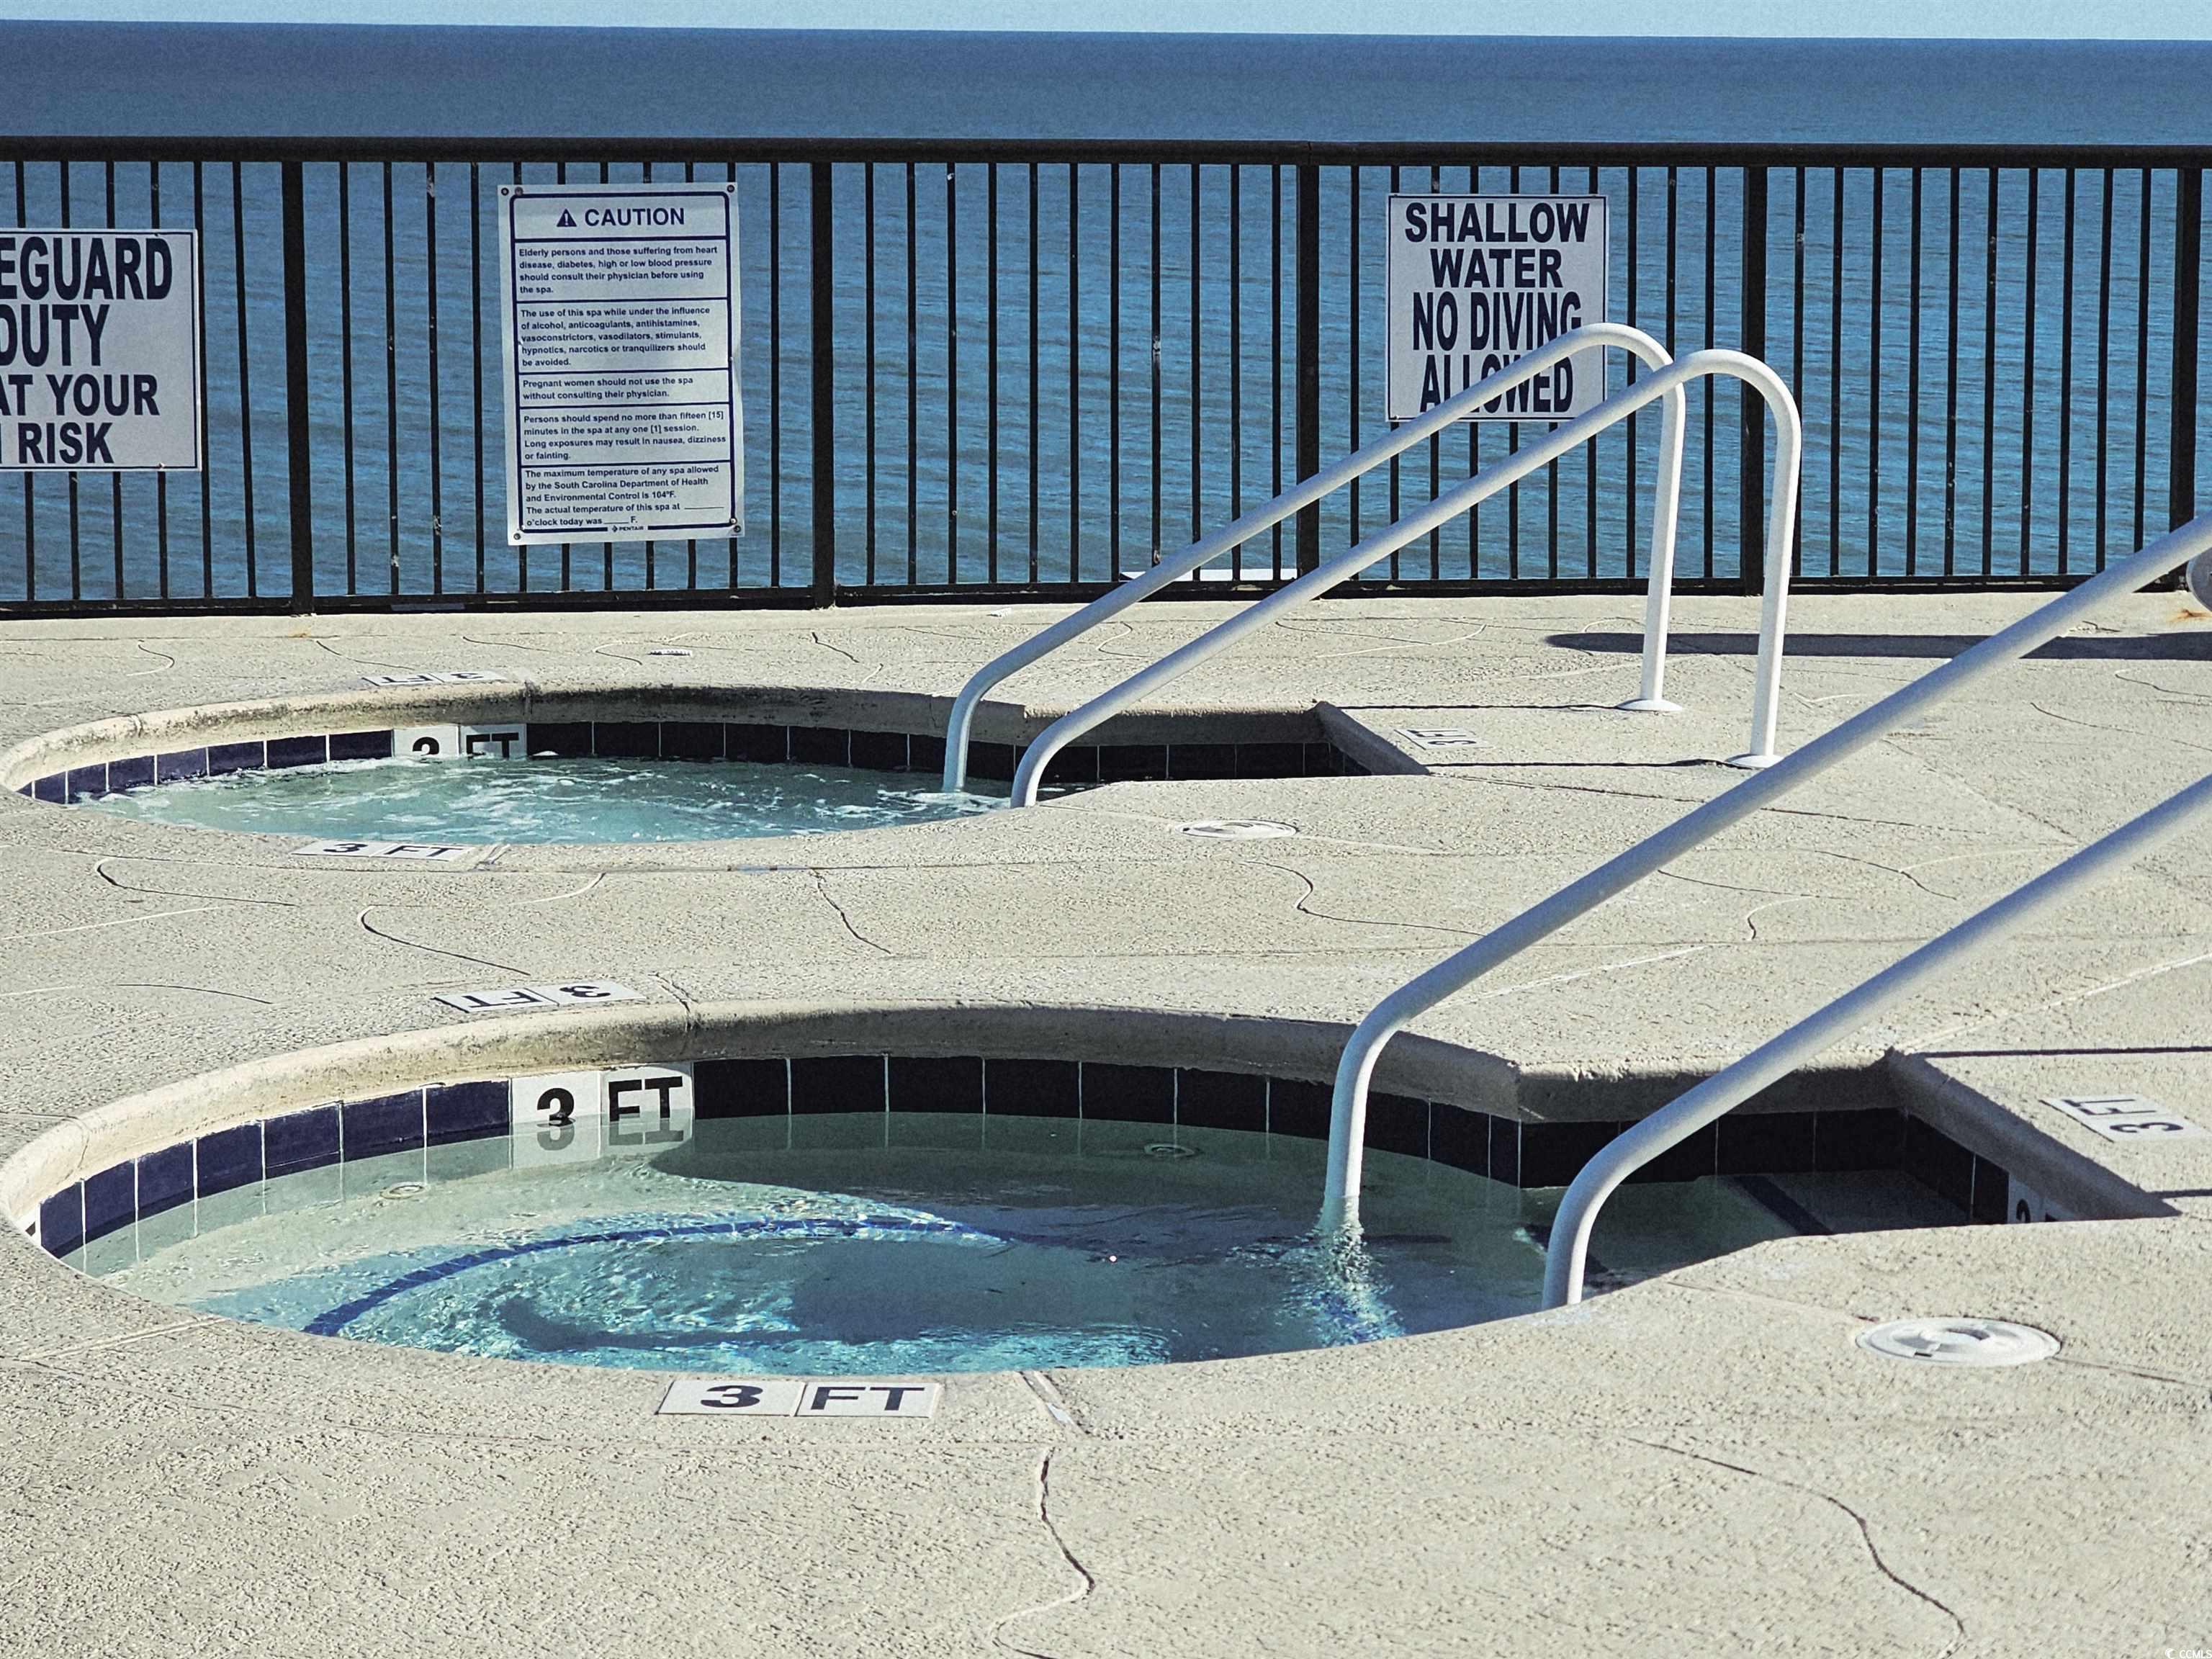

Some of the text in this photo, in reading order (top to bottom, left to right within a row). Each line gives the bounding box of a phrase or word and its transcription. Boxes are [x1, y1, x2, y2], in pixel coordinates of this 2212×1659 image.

[585, 207, 684, 226] CAUTION
[1405, 202, 1590, 243] SHALLOW
[519, 248, 549, 258] Elderly
[633, 246, 671, 256] suffering
[598, 259, 617, 269] high
[675, 259, 712, 268] pressure
[1429, 248, 1563, 288] WATER
[607, 271, 649, 282] physician
[680, 270, 703, 279] using
[521, 321, 530, 330] of
[531, 321, 566, 330] alcohol,
[568, 320, 634, 329] anticoagulants,
[1413, 291, 1582, 351] NO DIVING
[0, 304, 110, 367] DUTY
[521, 333, 596, 342] vasoconstrictors,
[522, 346, 567, 356] hypnotics,
[569, 344, 608, 353] narcotics
[622, 343, 675, 353] tranquilizers
[535, 357, 571, 366] avoided.
[523, 379, 562, 389] Pregnant
[597, 377, 626, 386] should
[46, 374, 160, 415] YOUR
[557, 391, 603, 400] consulting
[626, 389, 669, 399] physician.
[593, 413, 619, 423] spend
[709, 410, 724, 420] [15]
[650, 424, 662, 434] [1]
[18, 422, 114, 464] RISK
[524, 440, 547, 449] Long
[536, 451, 571, 460] fainting.
[588, 468, 639, 477] temperature
[687, 464, 719, 473] allowed
[526, 482, 536, 491] by
[620, 479, 669, 488] Department
[544, 493, 606, 501] Environmental
[572, 505, 624, 514] temperature
[559, 518, 584, 526] today
[323, 843, 465, 857] 3 FT
[461, 985, 611, 1007] 3 FT
[536, 1076, 683, 1125] 3 FT
[700, 1385, 925, 1411] 3 FT
